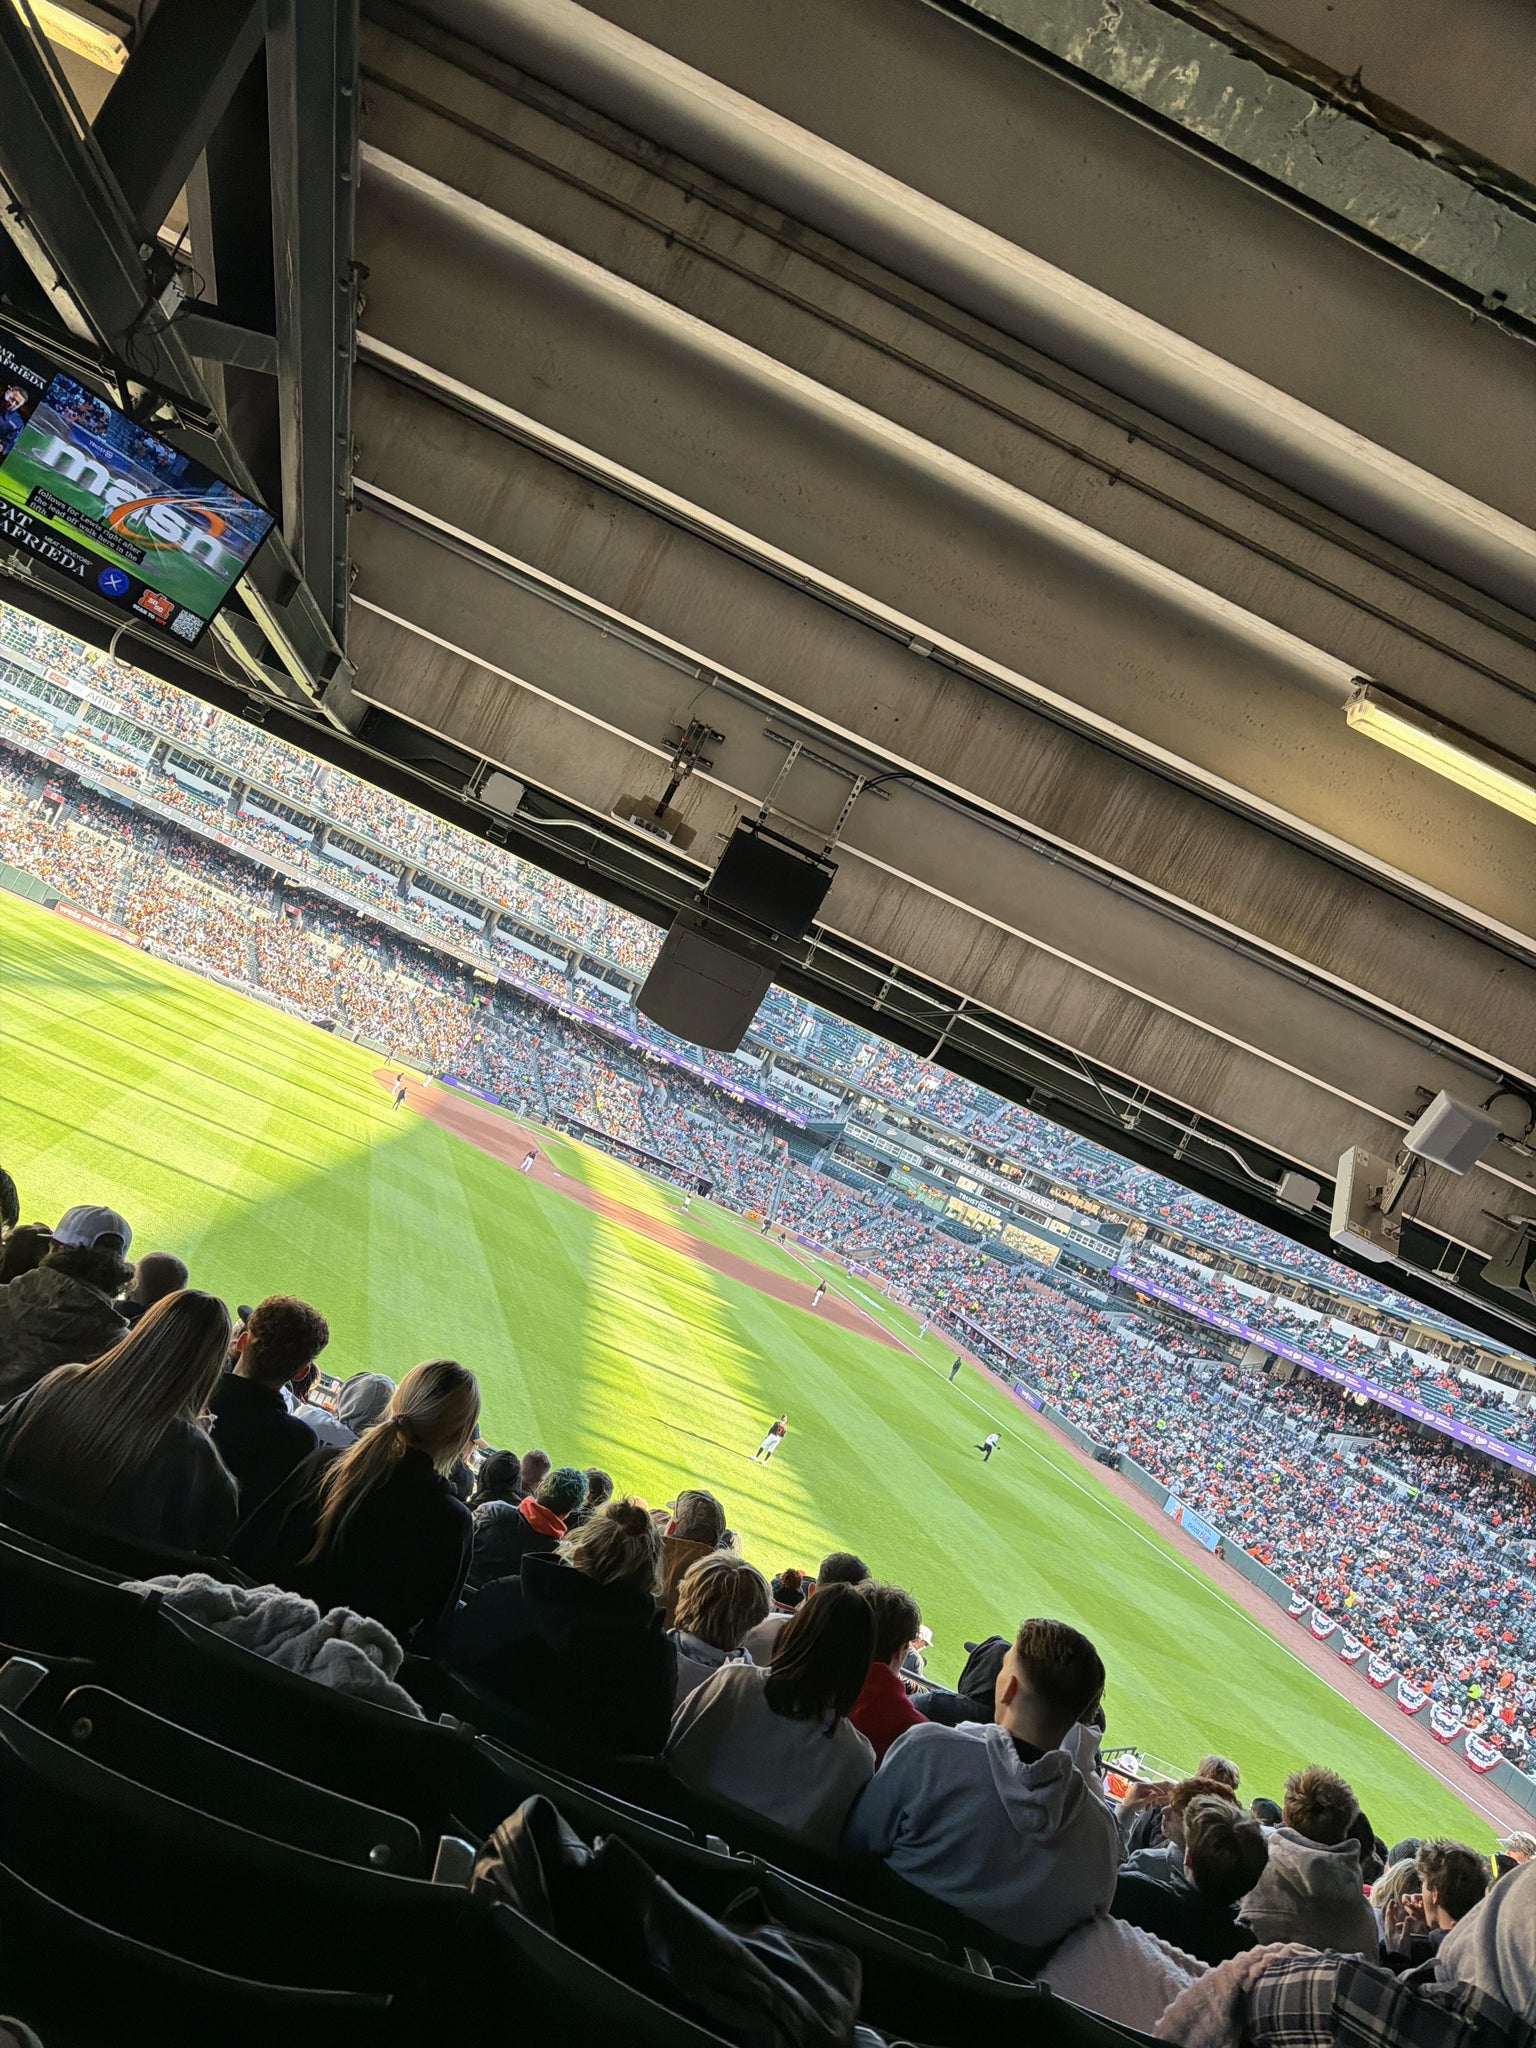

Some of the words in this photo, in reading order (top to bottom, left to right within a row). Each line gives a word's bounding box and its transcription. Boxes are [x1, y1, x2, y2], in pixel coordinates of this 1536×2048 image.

[29, 501, 48, 517] fifth.
[40, 437, 224, 567] masn
[33, 495, 48, 507] the
[48, 504, 66, 518] lead
[66, 515, 81, 526] off
[79, 522, 98, 538] walk
[97, 534, 116, 549] here
[115, 545, 124, 554] in
[124, 549, 138, 562] the
[38, 489, 66, 509] follows
[67, 506, 80, 516] for
[80, 513, 102, 531] Lewis
[103, 528, 122, 544] right
[122, 540, 142, 555] after
[43, 535, 60, 547] MEAT
[147, 611, 156, 619] TO
[64, 758, 102, 780] BRADISH
[231, 841, 247, 853] LEE
[948, 1157, 976, 1175] ORIOLE
[974, 1170, 996, 1184] PARK
[1000, 1181, 1034, 1201] CAMDEN
[1031, 1193, 1056, 1212] YARDS
[959, 1192, 979, 1206] TRUIST
[985, 1206, 1001, 1217] CLUB
